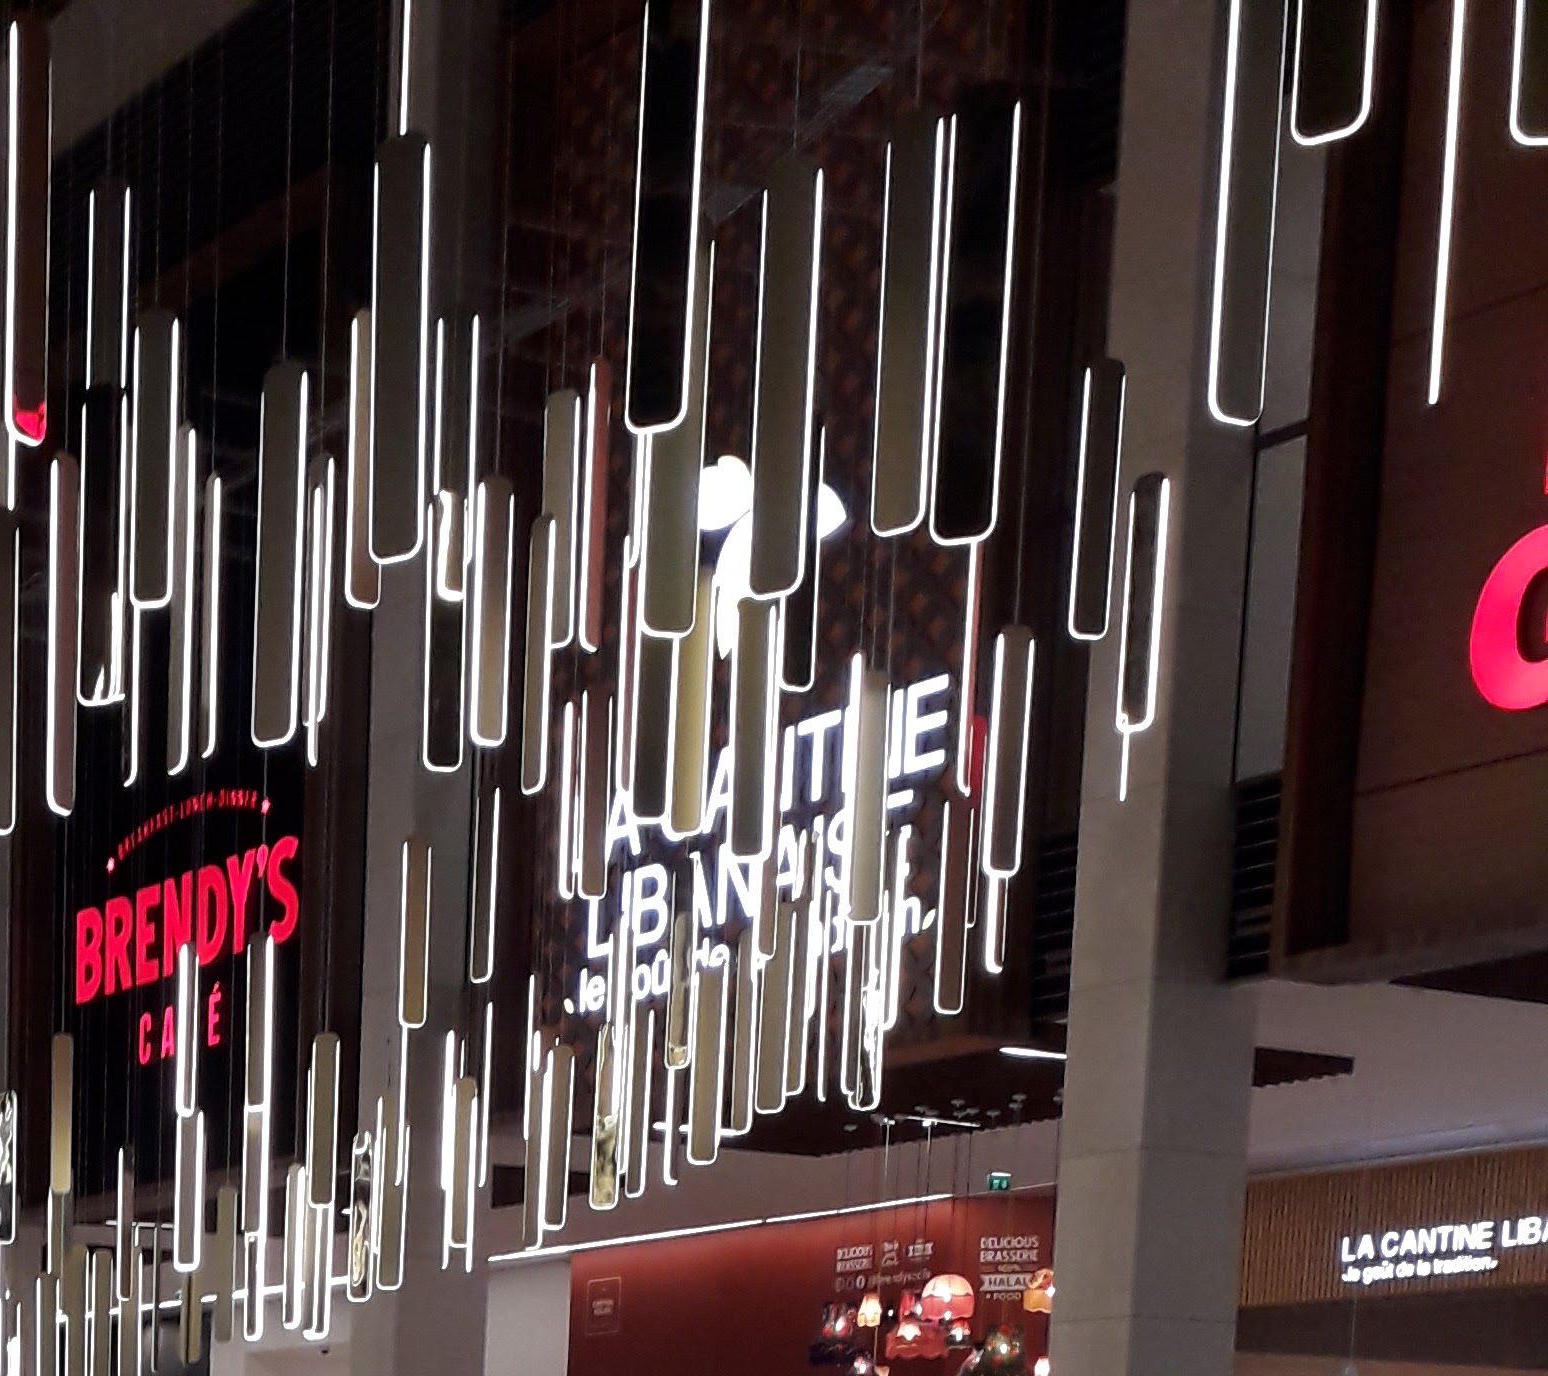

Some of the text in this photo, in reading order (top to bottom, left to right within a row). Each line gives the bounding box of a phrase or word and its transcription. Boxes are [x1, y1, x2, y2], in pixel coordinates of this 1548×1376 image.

[76, 835, 299, 1006] BRENDY'S
[138, 980, 222, 1066] CAÉ
[1341, 1234, 1375, 1262] LA
[1381, 1221, 1494, 1258] CANTINE
